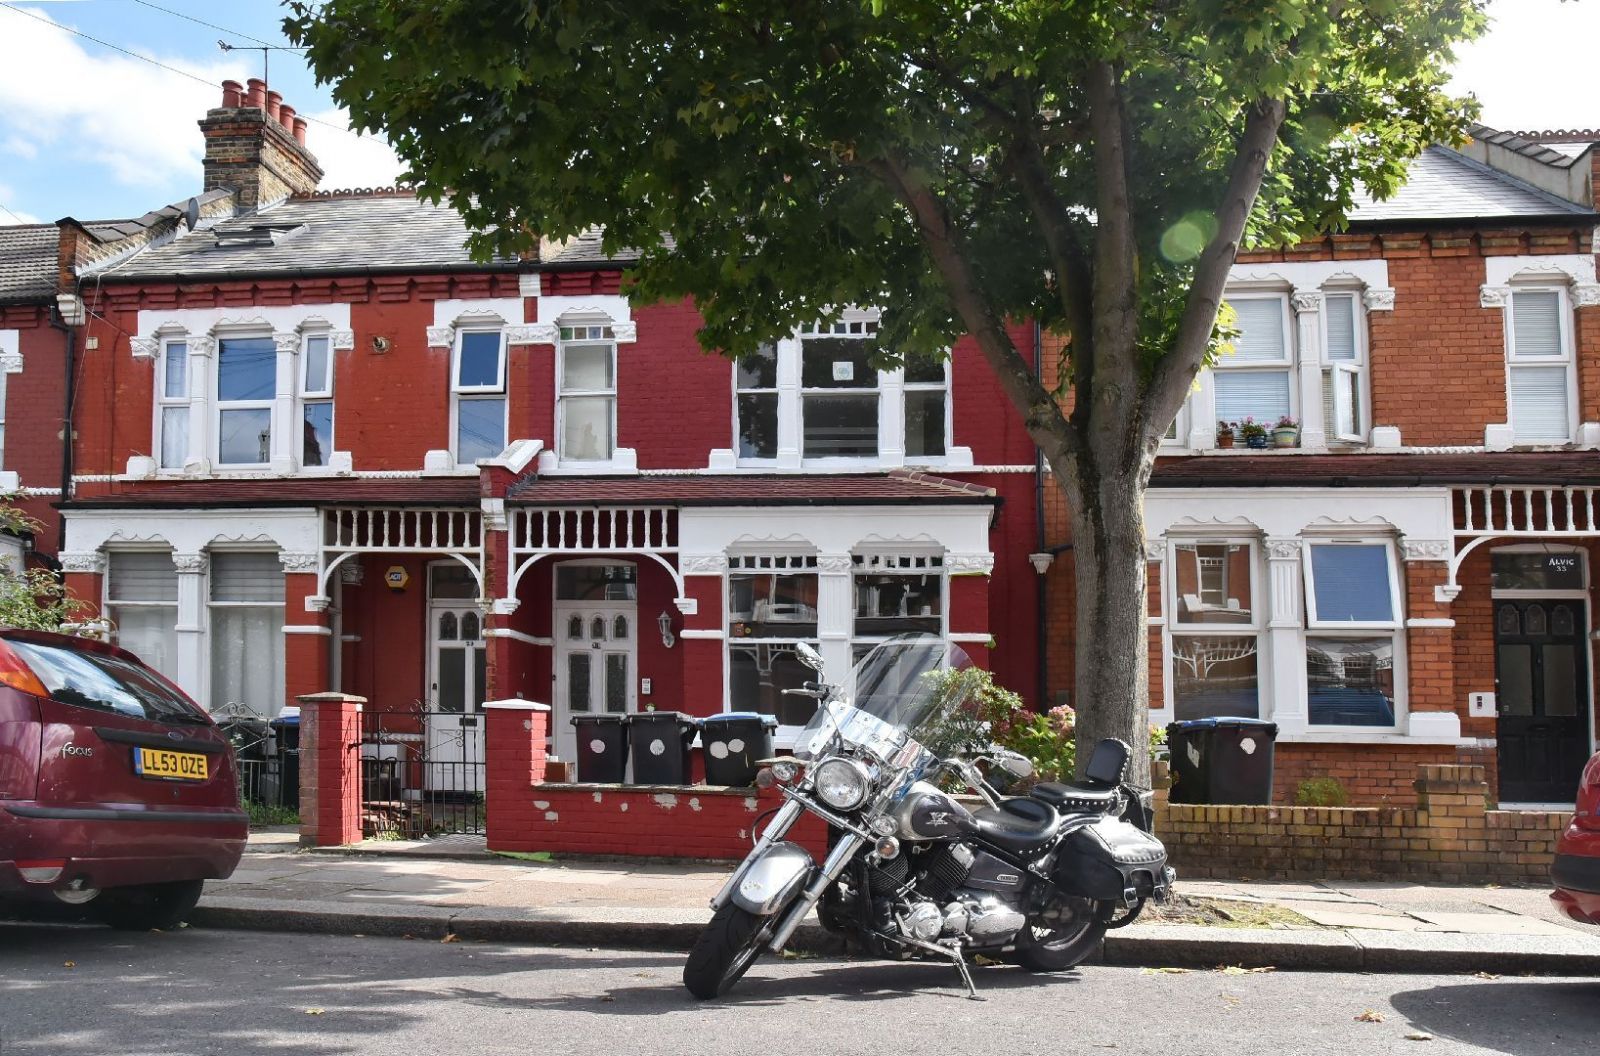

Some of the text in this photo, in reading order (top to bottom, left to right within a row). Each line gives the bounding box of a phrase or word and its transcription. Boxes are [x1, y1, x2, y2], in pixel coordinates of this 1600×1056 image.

[1548, 558, 1575, 566] ALVIC
[143, 750, 206, 776] LL53 OZE
